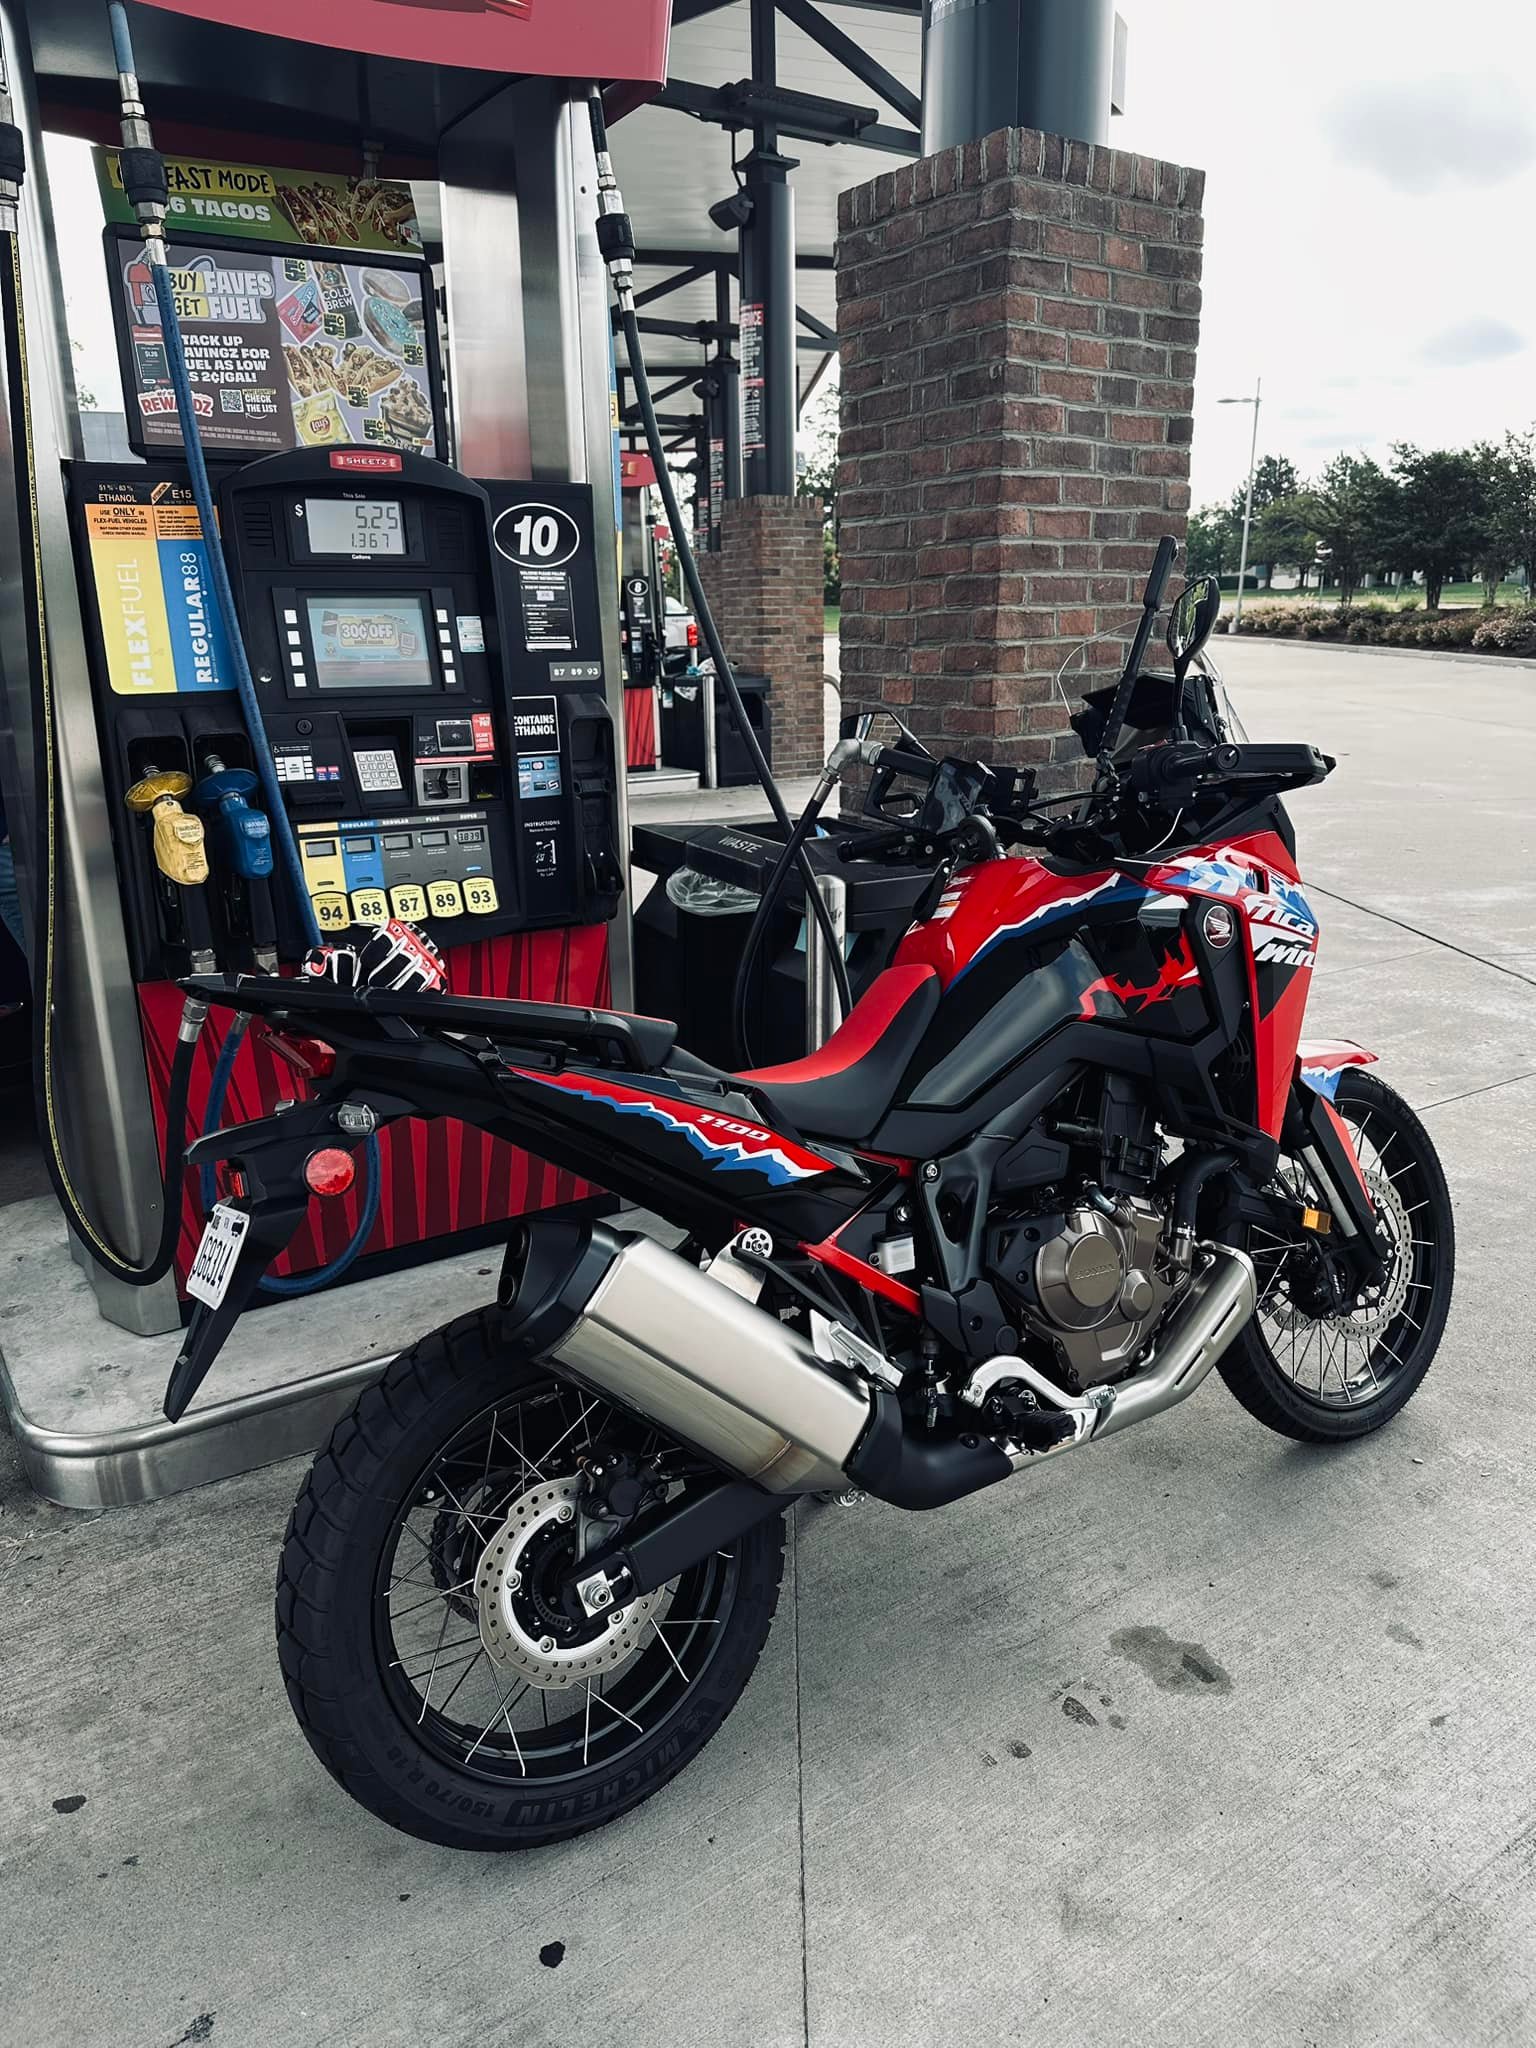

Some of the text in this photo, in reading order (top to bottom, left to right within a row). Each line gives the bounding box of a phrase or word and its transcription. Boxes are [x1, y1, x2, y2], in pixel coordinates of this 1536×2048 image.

[218, 169, 271, 194] MODE
[191, 198, 272, 222] TACOS
[170, 271, 273, 297] BUY FAVES
[323, 287, 350, 301] COLD
[175, 297, 200, 316] GET
[208, 297, 263, 321] FUEL
[327, 296, 353, 311] BREW
[182, 335, 243, 347] TACK UP
[184, 347, 270, 360] AVINGZ FOR
[186, 359, 267, 371] UEL AS LOW
[188, 371, 199, 382] S
[244, 393, 272, 403] CHECK
[246, 404, 278, 414] THE LIST
[346, 457, 388, 466] SHEETZ
[98, 493, 137, 503] ETHANOL
[172, 489, 192, 499] E15
[113, 507, 136, 516] ONLY
[295, 503, 304, 517] $
[355, 505, 398, 530] 5.25
[351, 532, 389, 548] 1.367
[513, 514, 559, 557] 10
[369, 623, 394, 639] OFF
[553, 667, 599, 677] 87 89 93
[524, 819, 560, 828] INSTRUCTIONS
[718, 835, 764, 854] WASTE
[436, 893, 457, 908] 89
[471, 889, 492, 904] 93
[361, 901, 383, 917] 88
[400, 897, 419, 912] 87
[319, 905, 344, 921] 94
[696, 1113, 771, 1142] 1100
[1074, 1263, 1117, 1280] HONDA
[517, 1737, 682, 1826] MICHELIN
[424, 1780, 497, 1820] 150/70
